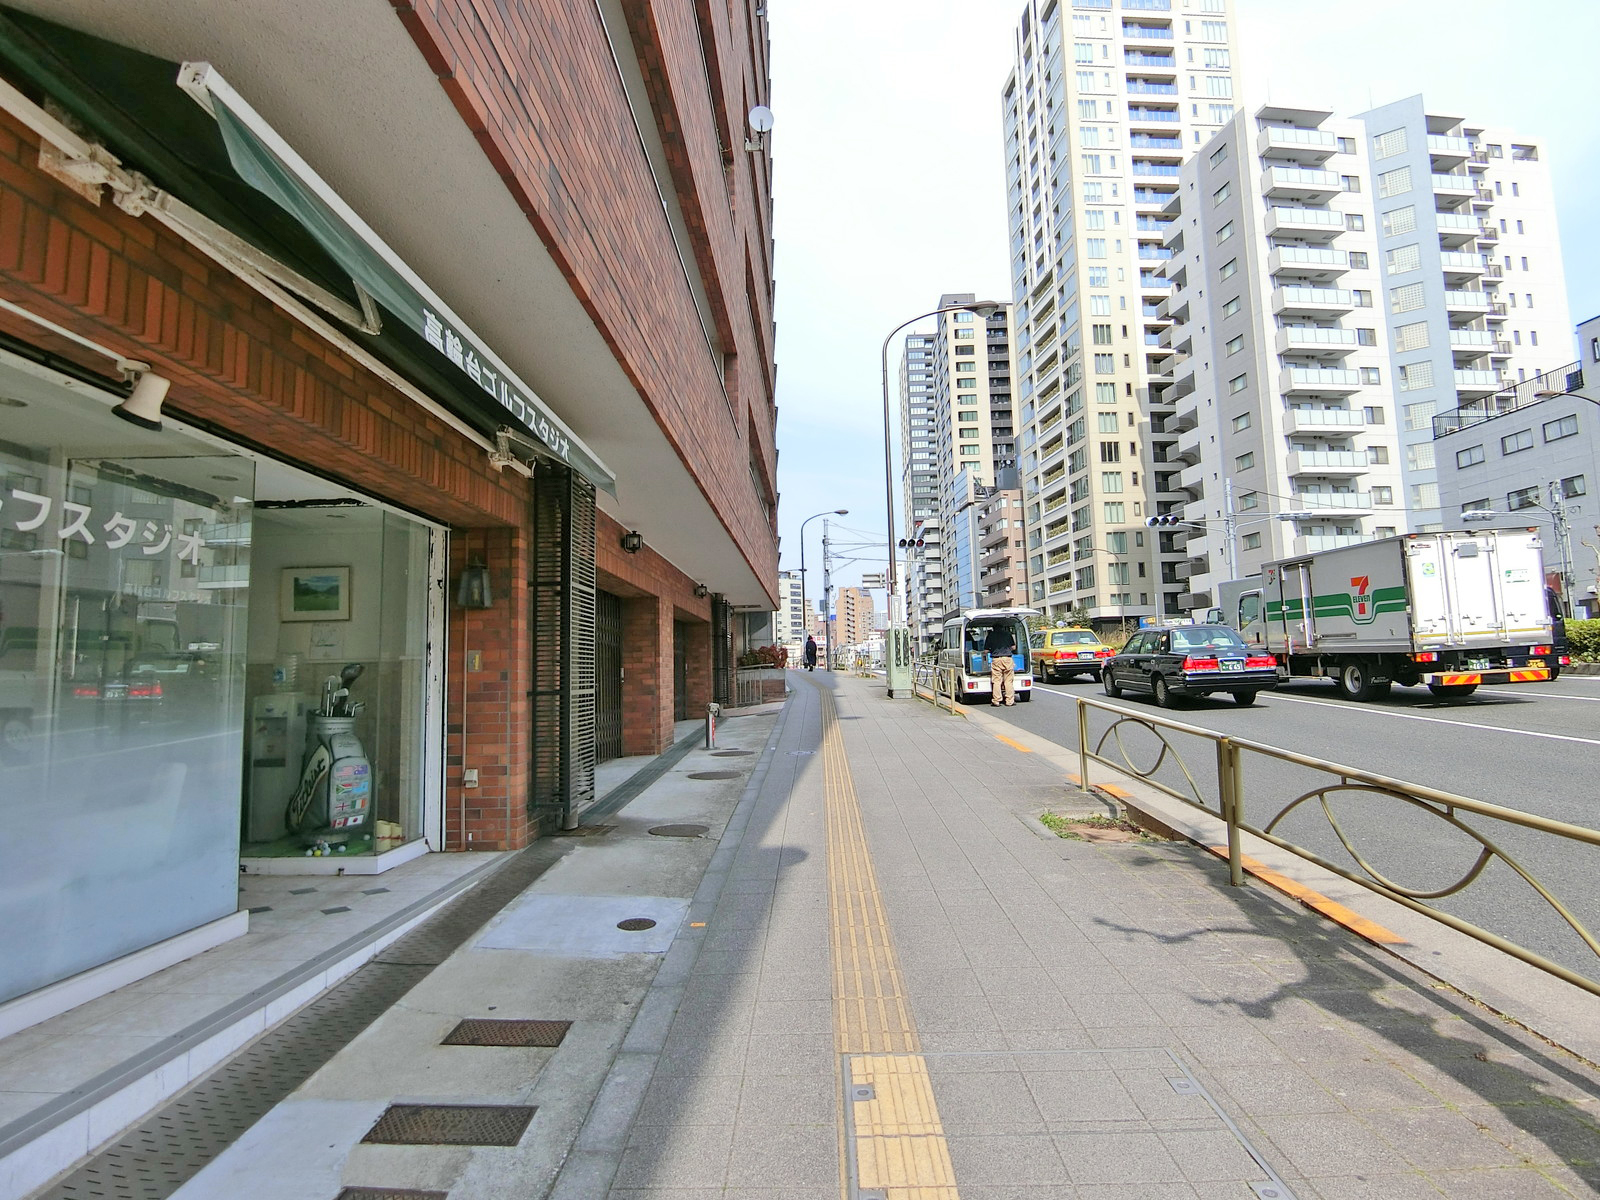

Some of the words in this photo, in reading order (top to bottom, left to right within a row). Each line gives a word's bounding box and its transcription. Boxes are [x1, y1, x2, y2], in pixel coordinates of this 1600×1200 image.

[423, 308, 570, 463] 高輪台ゴルフスタジオ
[0, 488, 206, 566] フスタジオ
